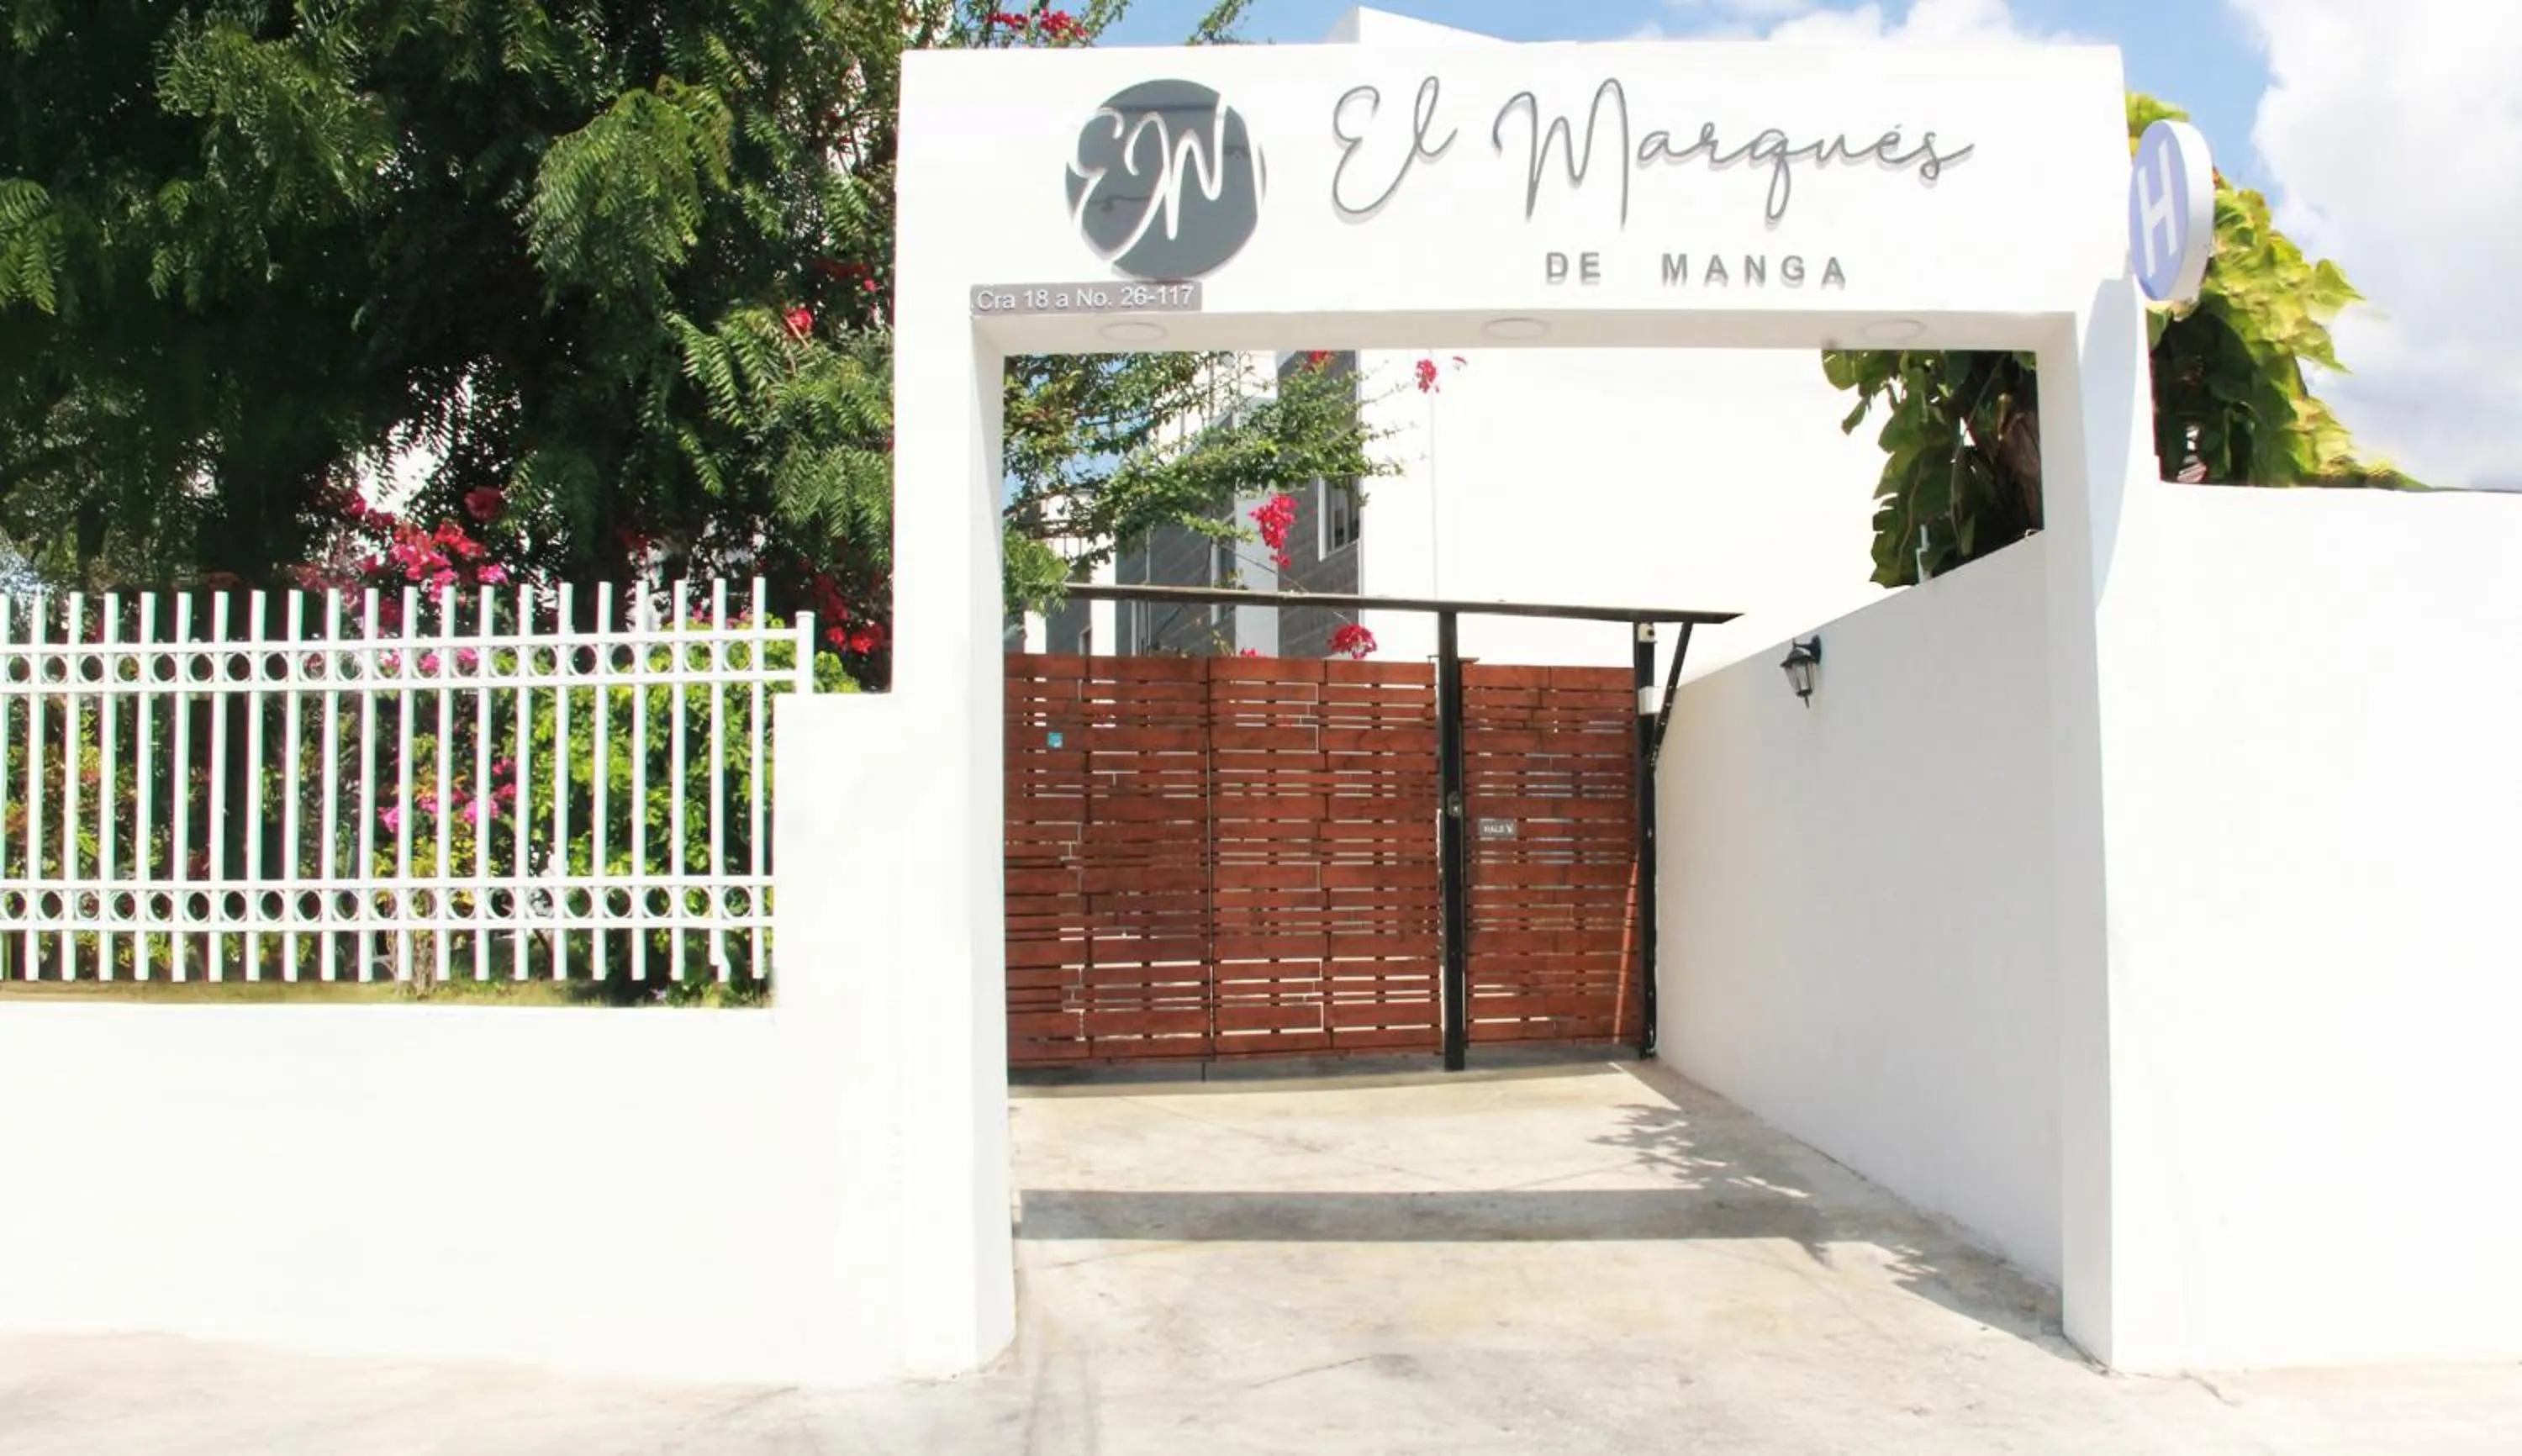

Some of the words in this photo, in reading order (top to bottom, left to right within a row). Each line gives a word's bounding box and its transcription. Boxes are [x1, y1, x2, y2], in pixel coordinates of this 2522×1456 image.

[1333, 76, 1458, 220] El
[1492, 77, 1975, 231] Marqués
[2137, 139, 2178, 278] H
[977, 290, 1016, 309] Cra
[1024, 289, 1049, 309] 18
[1055, 293, 1069, 308] a
[1077, 288, 1113, 307] No.
[1121, 285, 1194, 308] 26-117
[1546, 252, 1601, 285] DE
[1661, 253, 1845, 289] MANGA
